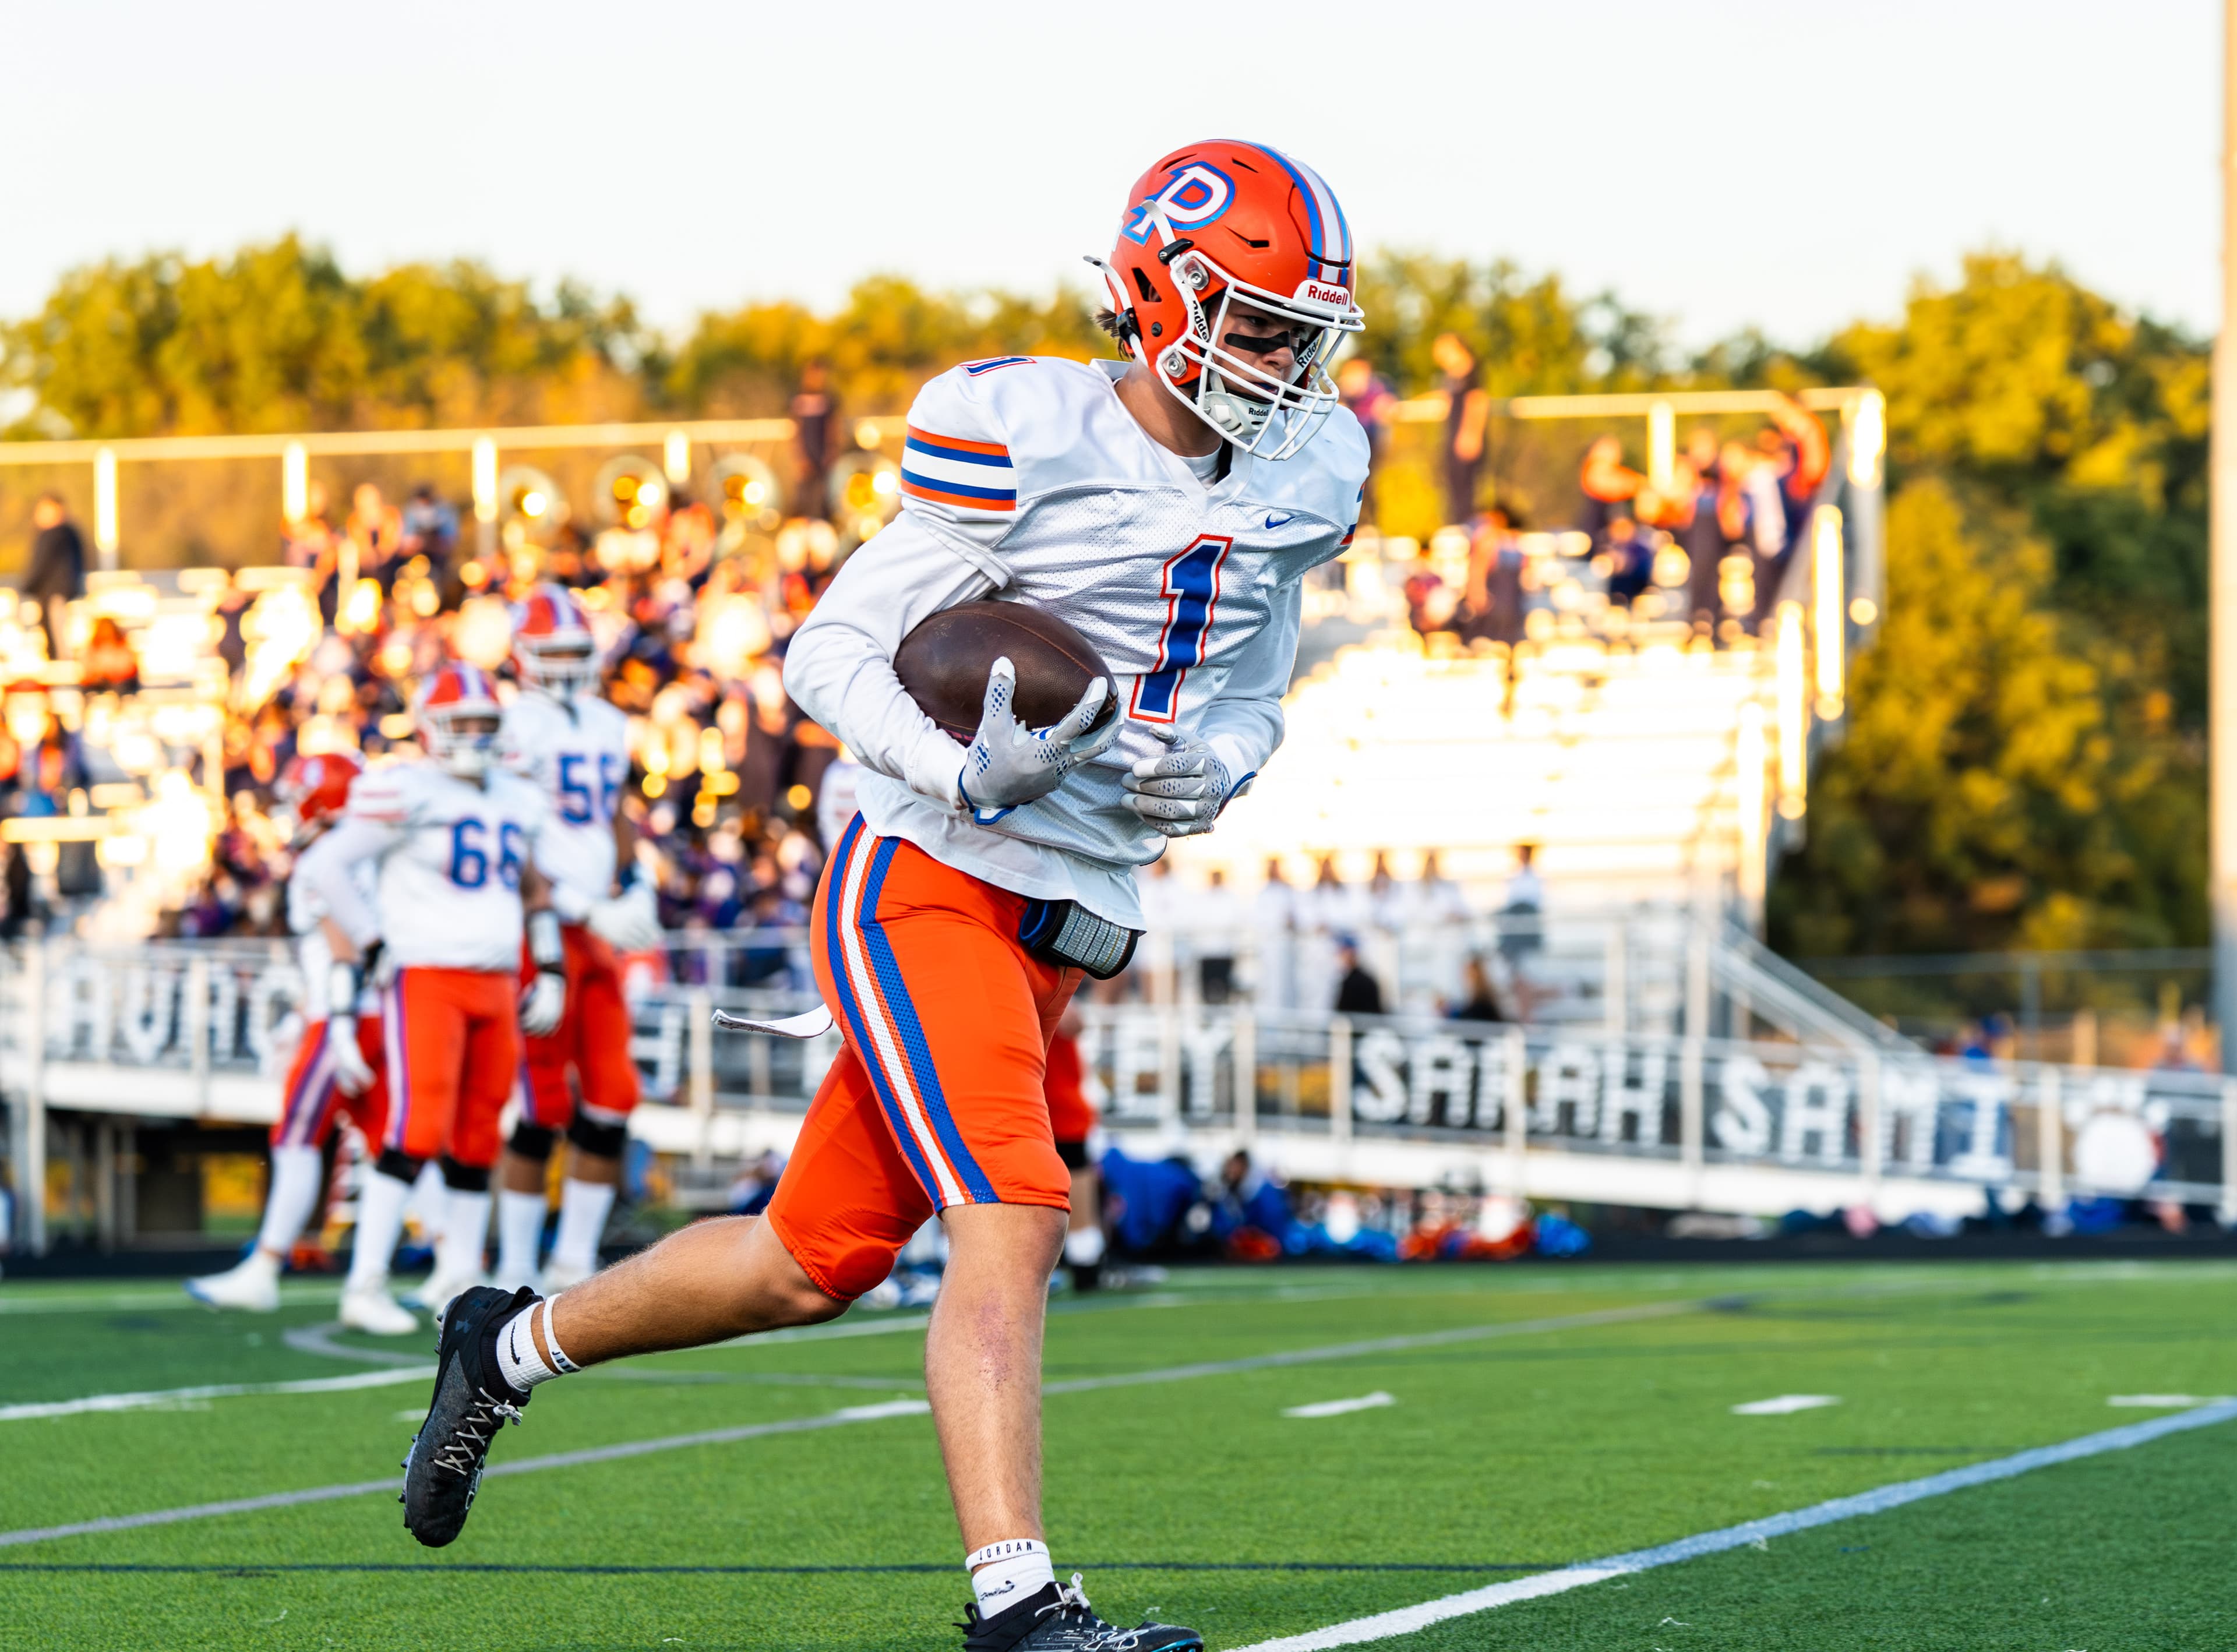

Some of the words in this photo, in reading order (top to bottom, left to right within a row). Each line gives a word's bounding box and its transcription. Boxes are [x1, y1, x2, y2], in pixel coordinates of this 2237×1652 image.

[1307, 284, 1348, 306] Riddell
[1130, 534, 1233, 723] 1
[979, 1541, 1032, 1561] JORDAN
